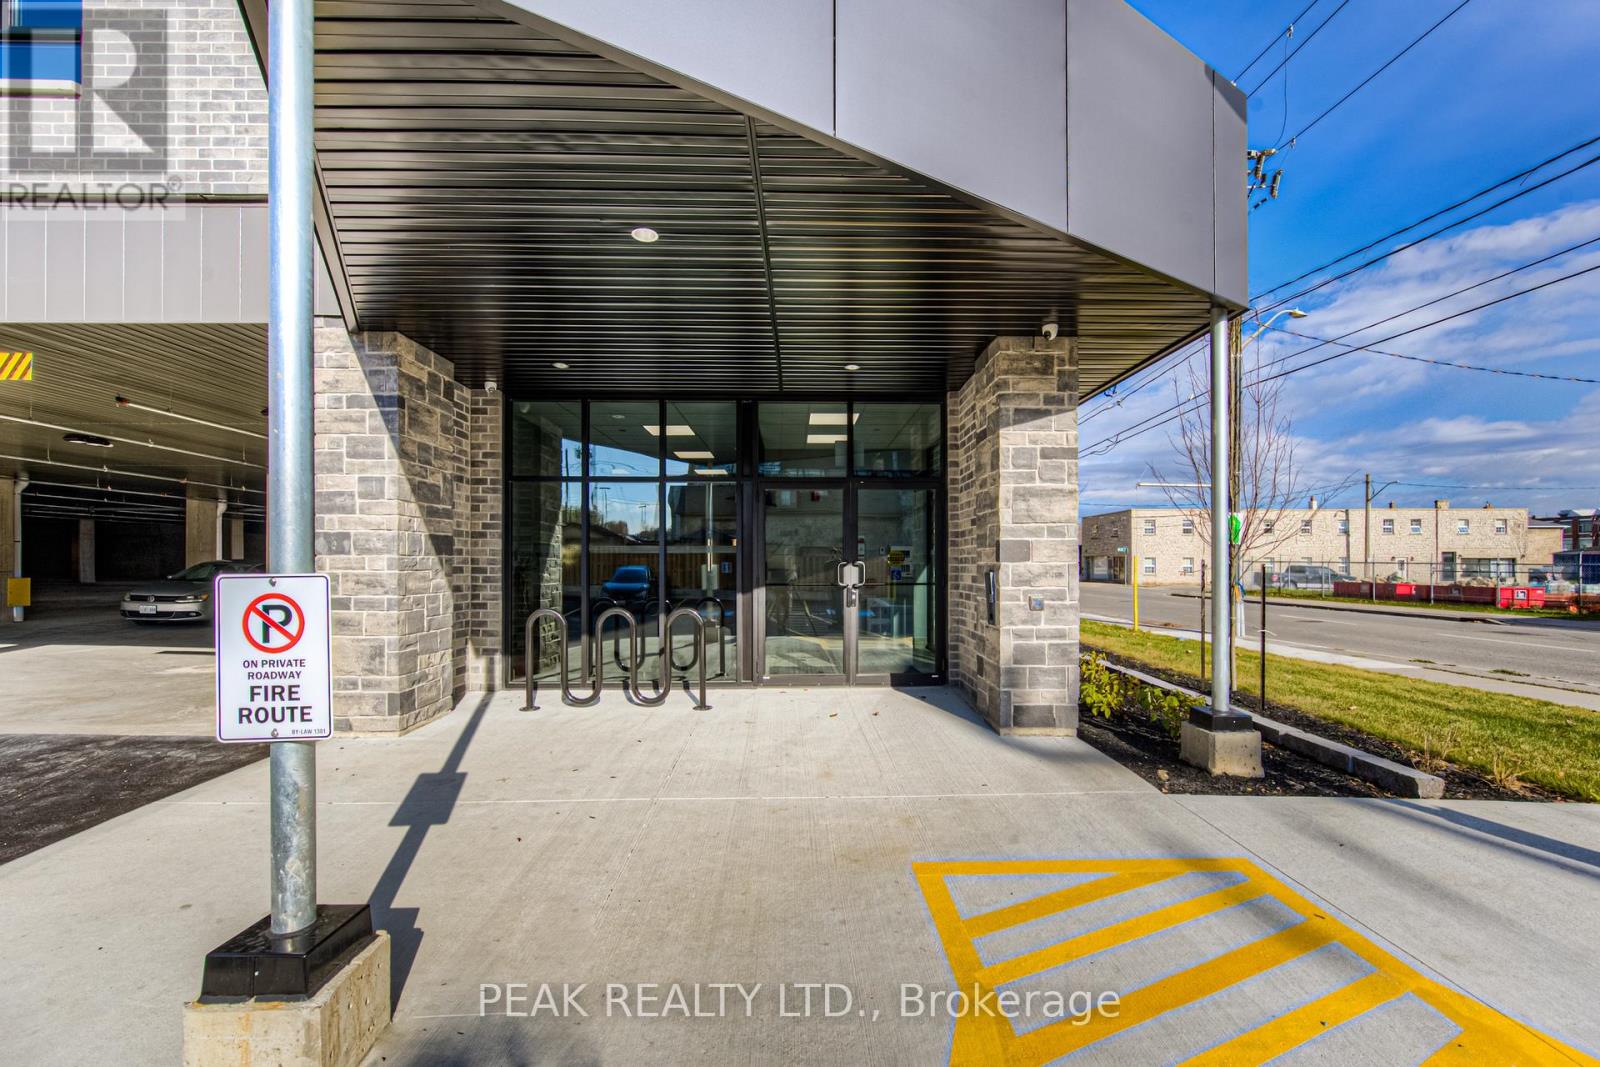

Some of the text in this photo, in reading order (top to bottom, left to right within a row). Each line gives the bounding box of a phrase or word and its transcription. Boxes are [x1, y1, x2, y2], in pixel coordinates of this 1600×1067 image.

[243, 658, 306, 669] ON PRIVATE
[247, 670, 302, 681] ROADWAY
[249, 684, 301, 702] FIRE
[238, 705, 313, 725] ROUTE
